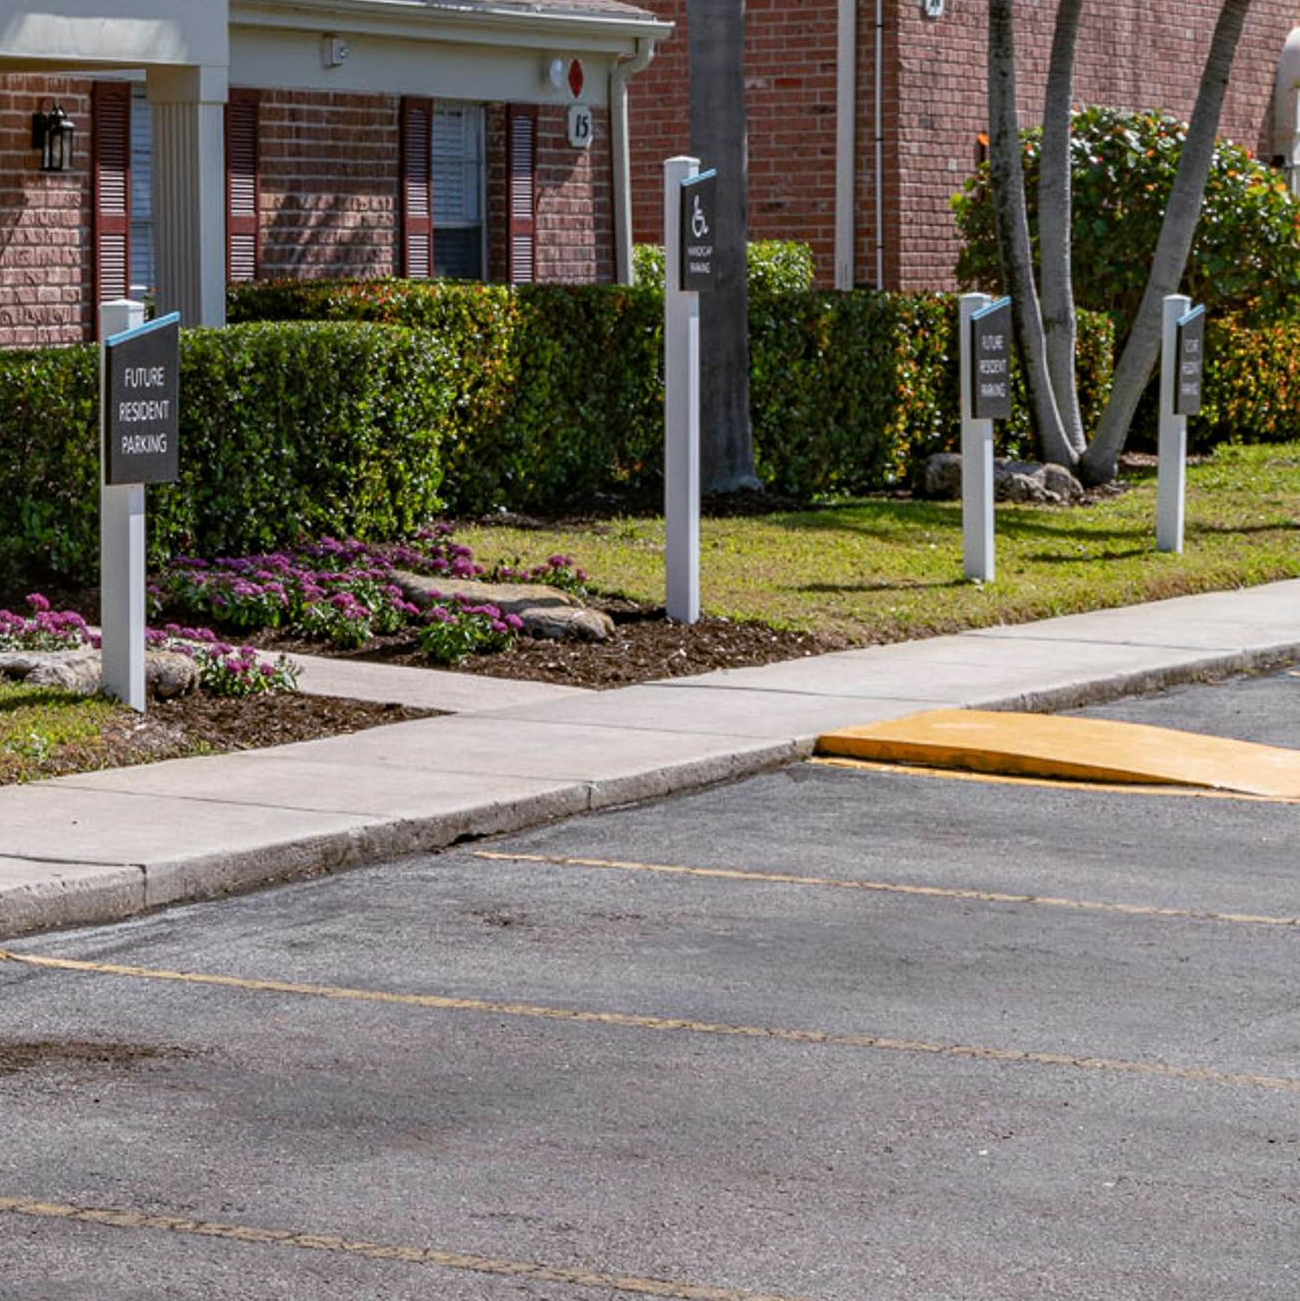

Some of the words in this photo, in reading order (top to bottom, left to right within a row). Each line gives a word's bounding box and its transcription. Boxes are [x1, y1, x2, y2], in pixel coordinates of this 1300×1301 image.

[575, 114, 589, 138] 15
[124, 366, 166, 388] FUTURE
[118, 400, 170, 422] RESIDENT
[121, 433, 168, 454] PARKING
